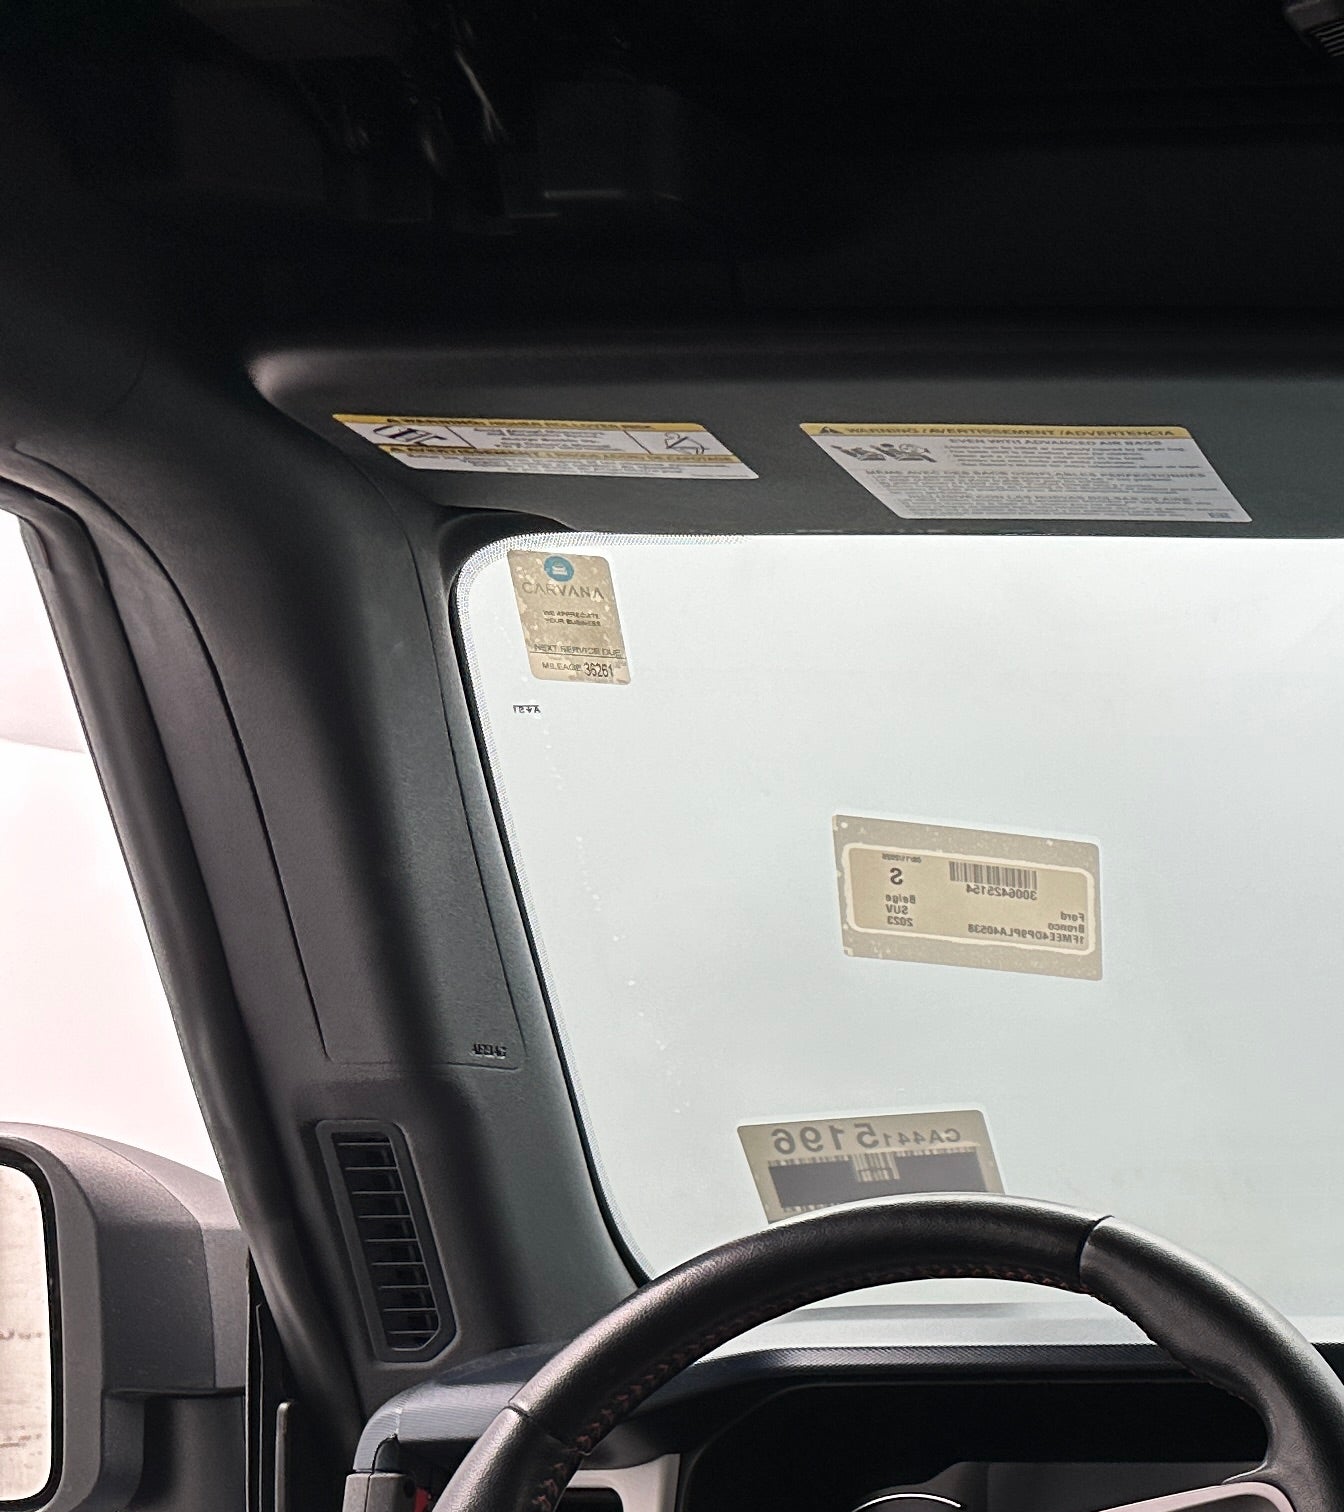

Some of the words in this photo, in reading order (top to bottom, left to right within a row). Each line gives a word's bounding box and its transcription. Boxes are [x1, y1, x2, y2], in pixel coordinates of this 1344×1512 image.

[521, 582, 604, 600] CARVANA
[534, 644, 557, 652] NEXT
[602, 648, 621, 656] DUE
